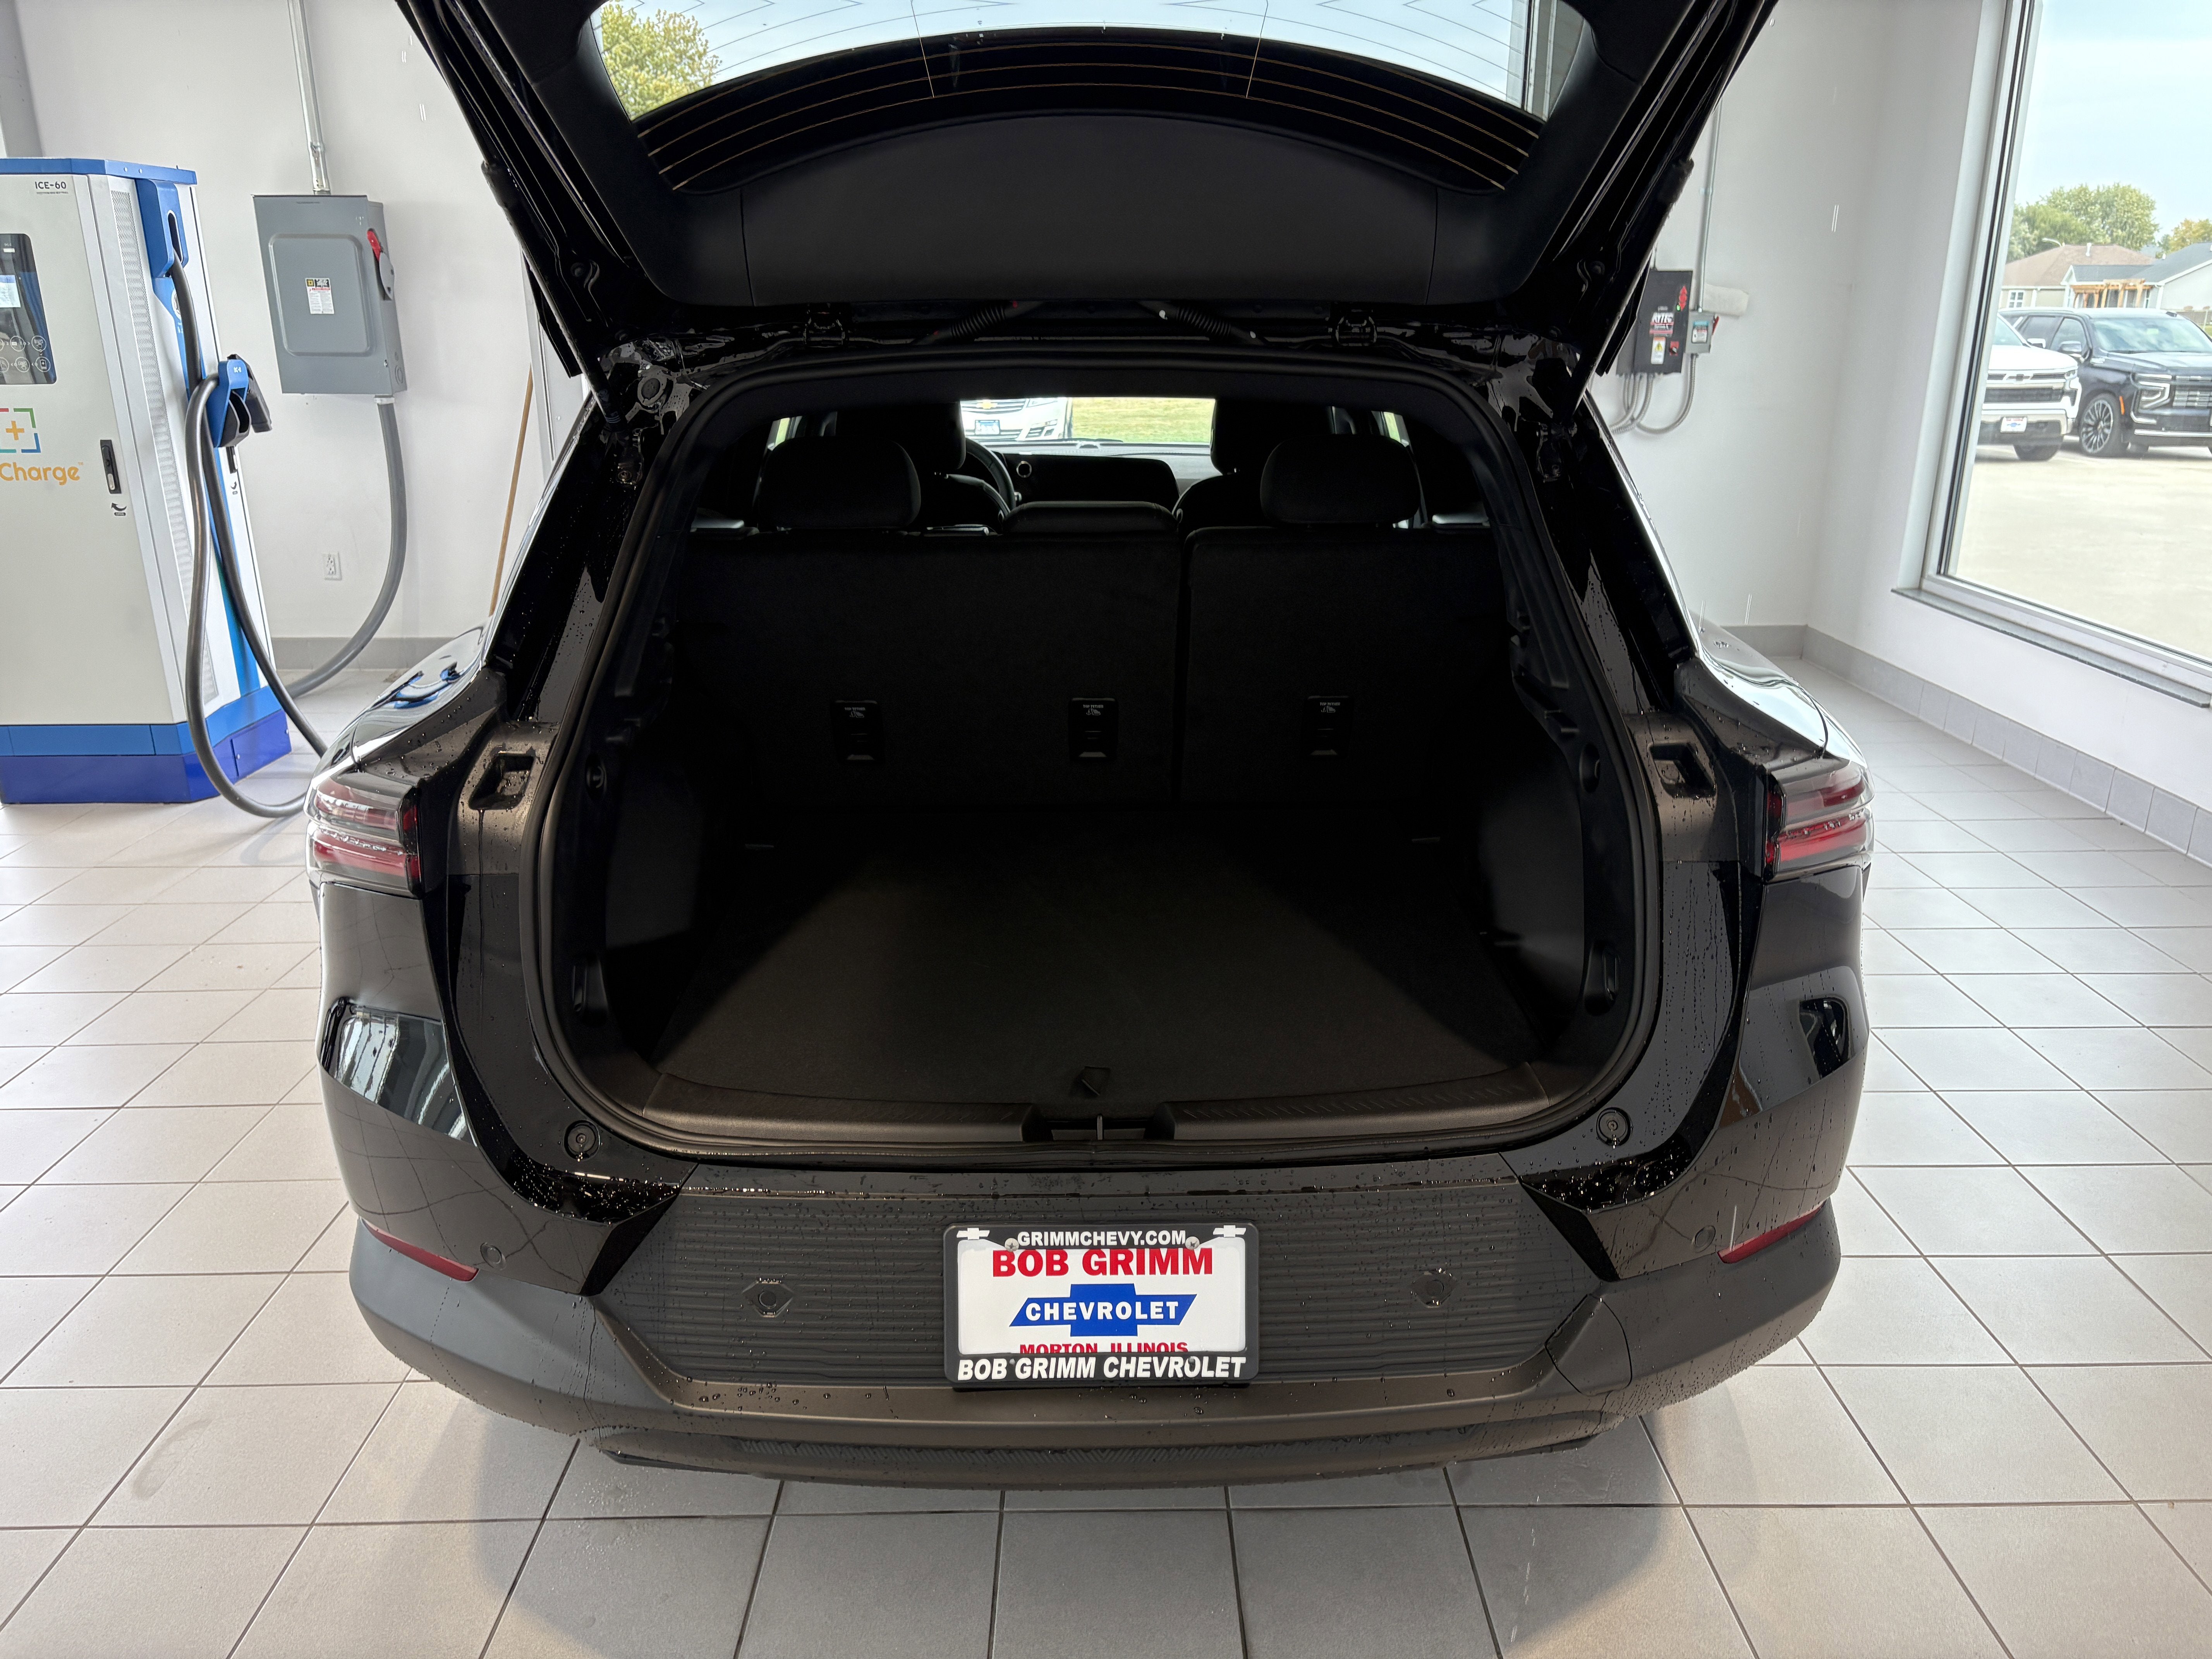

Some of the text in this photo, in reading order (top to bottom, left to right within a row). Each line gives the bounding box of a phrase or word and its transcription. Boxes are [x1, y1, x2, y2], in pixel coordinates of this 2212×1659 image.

[35, 181, 66, 189] ICE-60
[1018, 1230, 1186, 1246] GRIMMCHEVY.COM
[993, 1248, 1212, 1277] BOB GRIMM
[1025, 1301, 1179, 1321] CHEVROLET
[958, 1356, 1246, 1380] BOB GRIMM CHEVROLET
